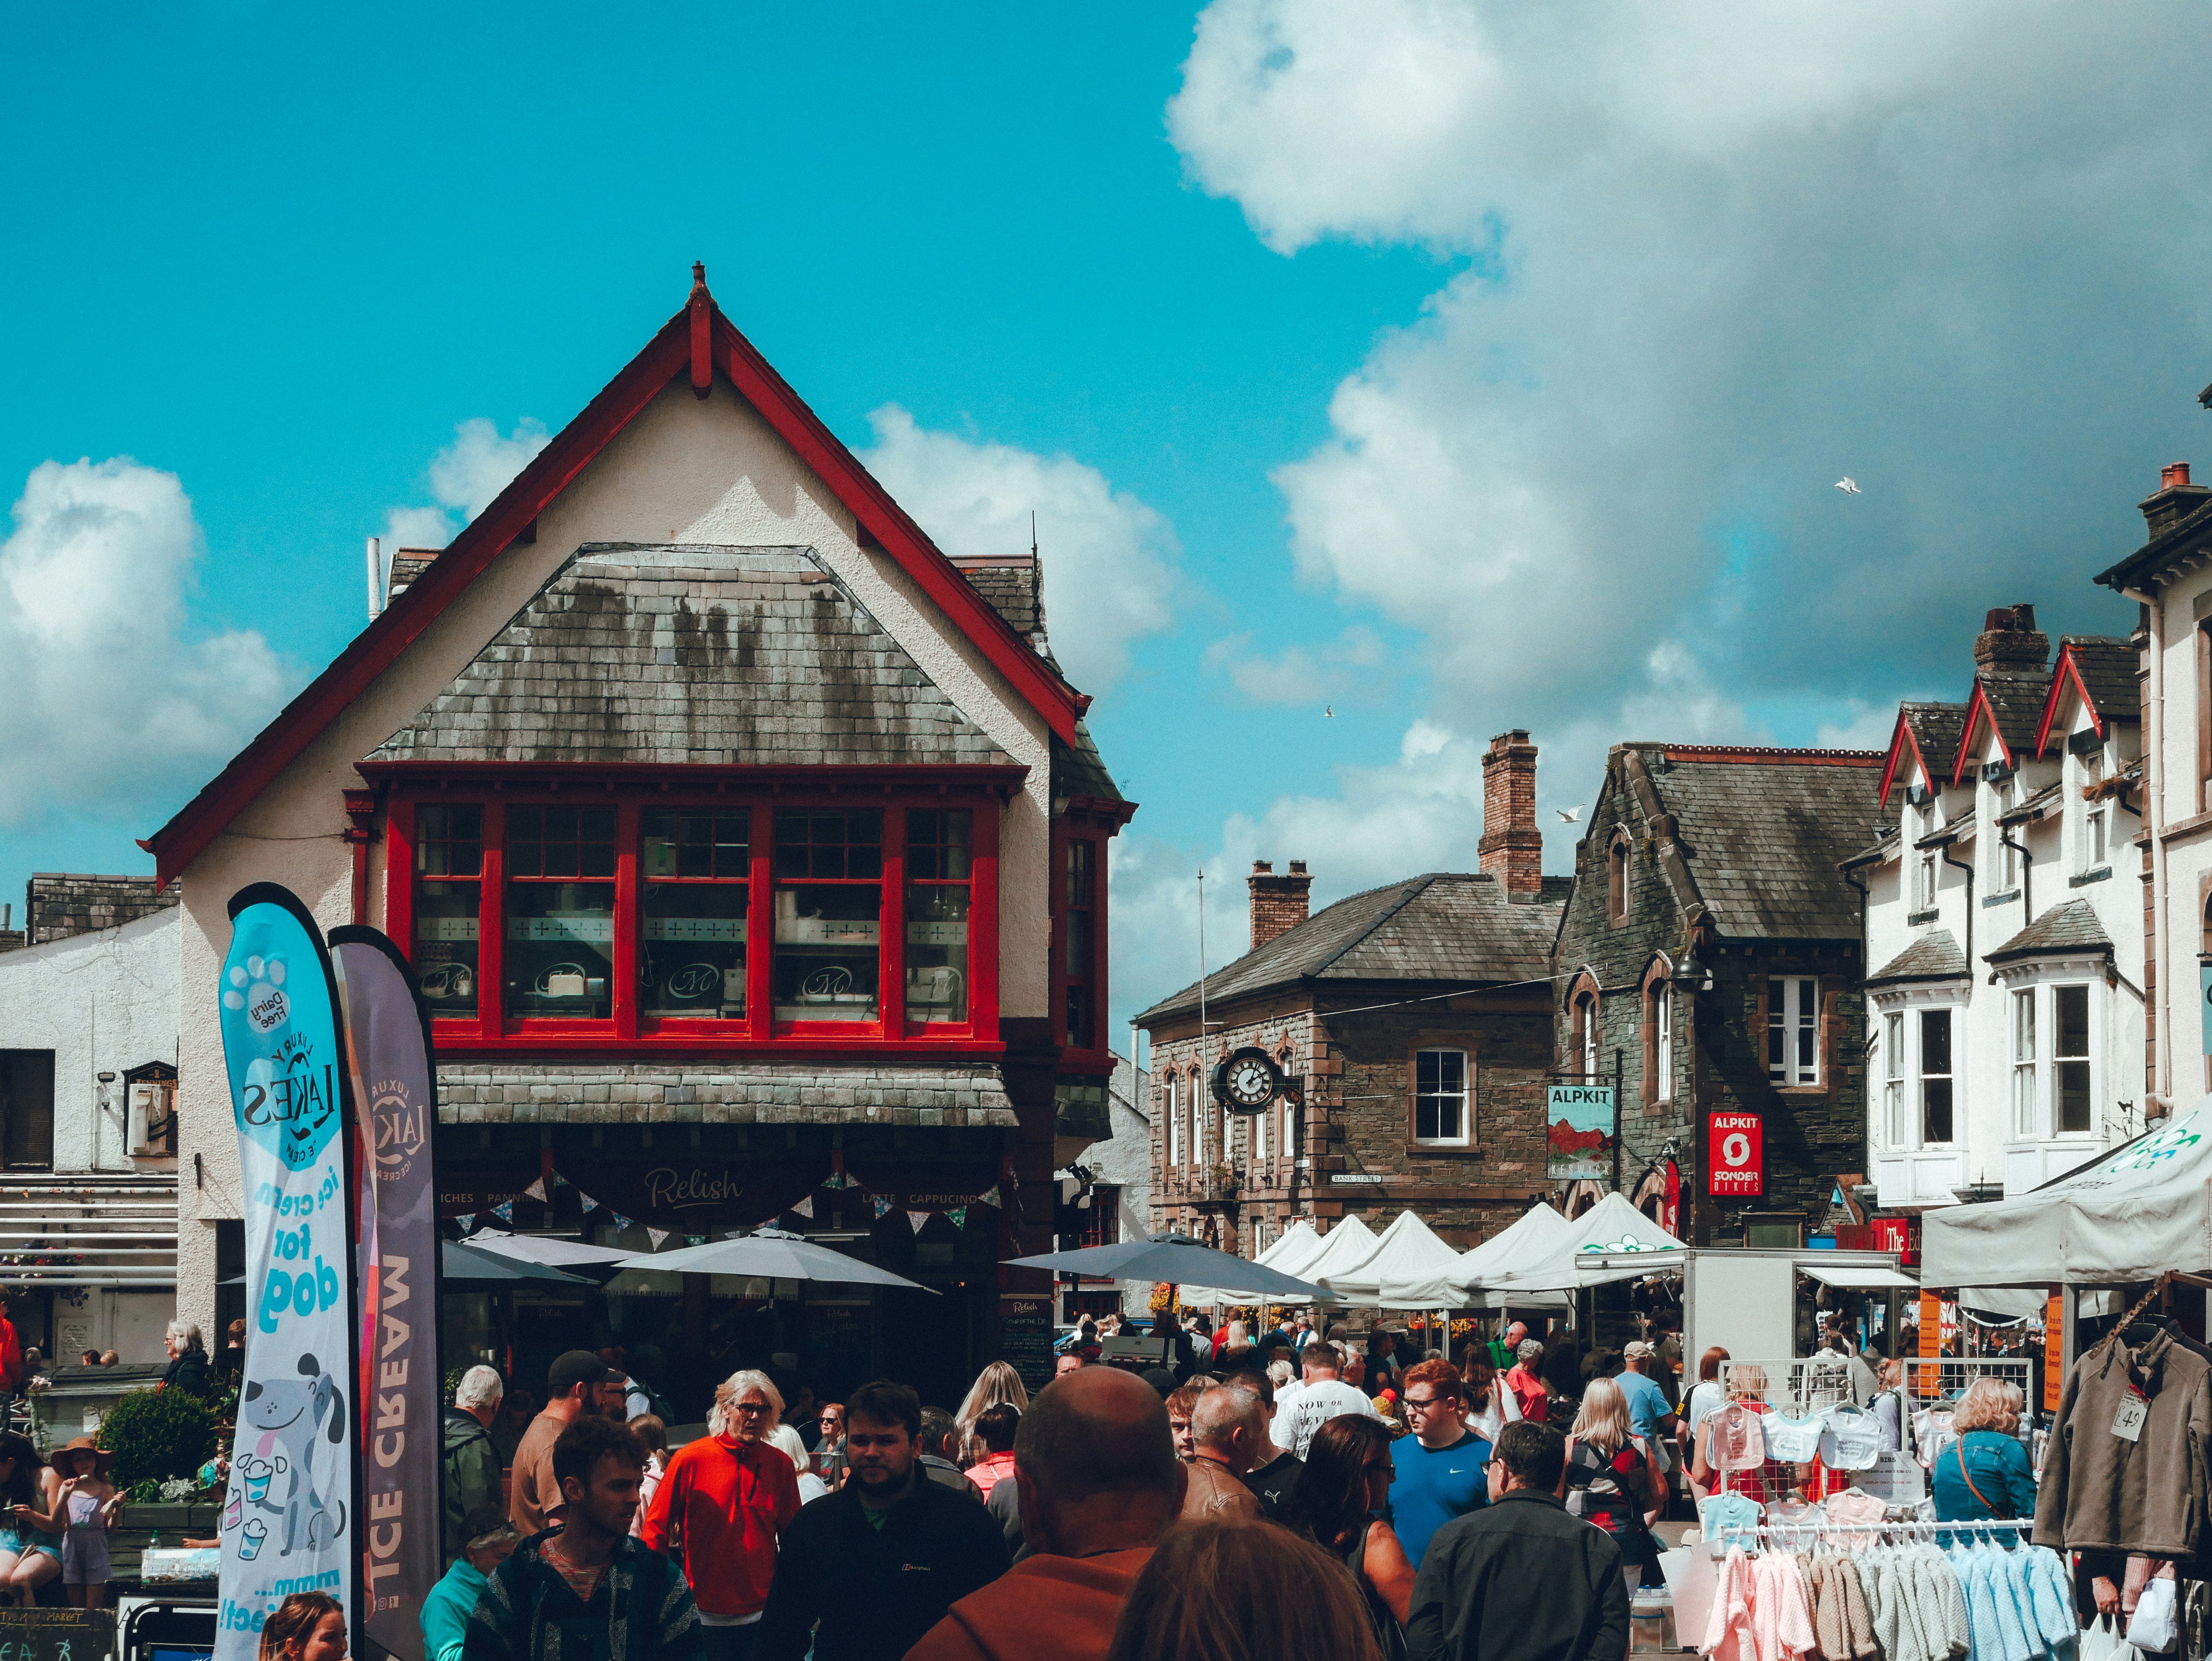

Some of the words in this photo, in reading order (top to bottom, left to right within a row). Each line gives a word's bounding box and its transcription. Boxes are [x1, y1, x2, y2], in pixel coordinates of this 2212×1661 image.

[1553, 1090, 1609, 1104] ALPKIT
[1714, 1117, 1758, 1128] ALPKIT
[1552, 1164, 1609, 1175] KESWICK
[1714, 1171, 1758, 1181] SONDER
[645, 1167, 744, 1208] Relish
[1714, 1182, 1758, 1191] BIKES
[440, 1193, 474, 1203] ICHES
[862, 1194, 896, 1203] LATE
[909, 1194, 977, 1204] CAPPUCINO
[1887, 1226, 1904, 1252] The
[1907, 1227, 1921, 1252] Ed
[1013, 1302, 1038, 1313] Relish
[1298, 1401, 1326, 1411] NOW
[1300, 1416, 1330, 1426] EVE
[2114, 1405, 2140, 1427] £49
[47, 1612, 84, 1623] MARKET
